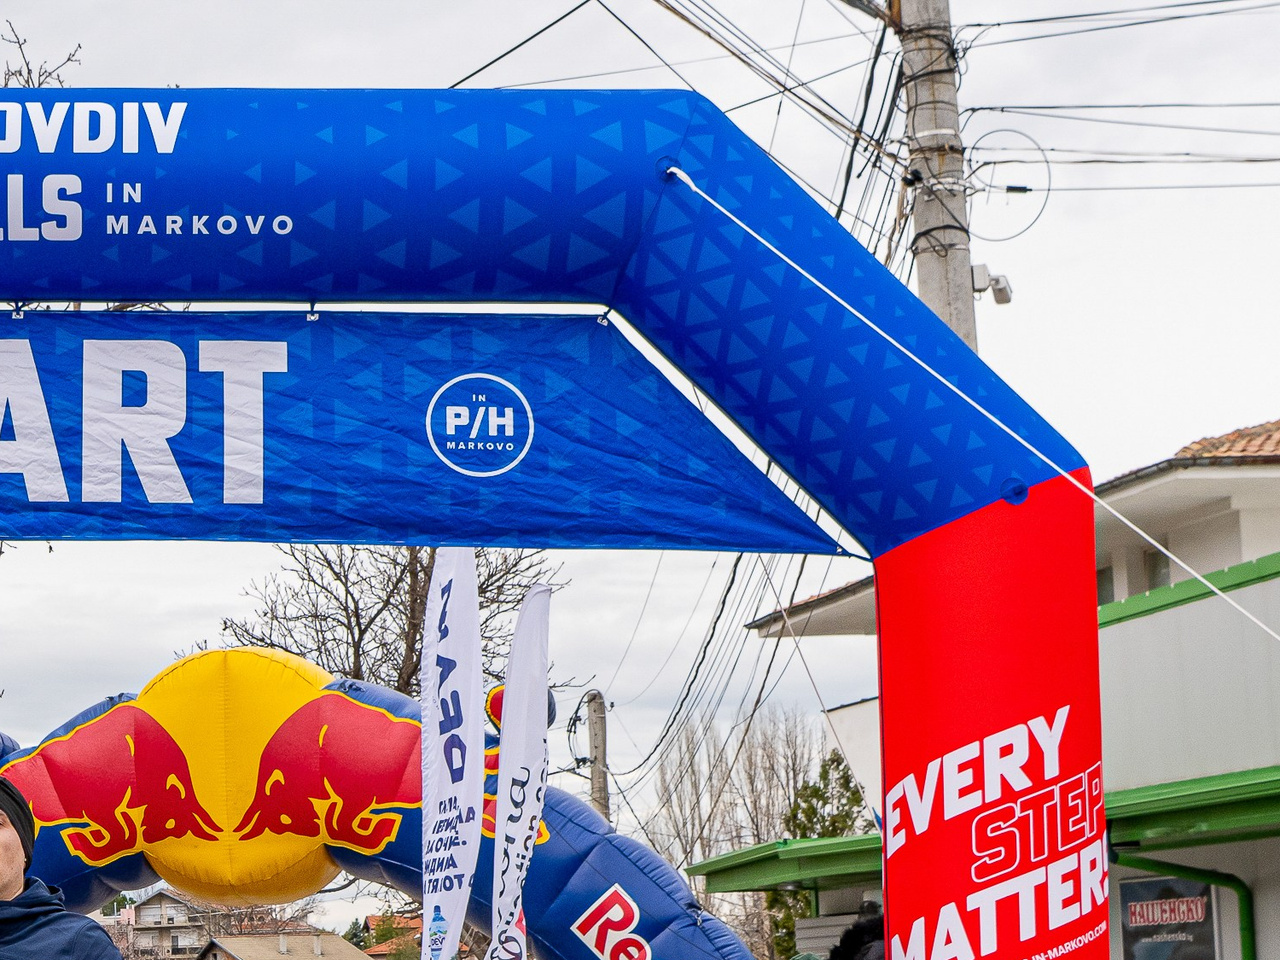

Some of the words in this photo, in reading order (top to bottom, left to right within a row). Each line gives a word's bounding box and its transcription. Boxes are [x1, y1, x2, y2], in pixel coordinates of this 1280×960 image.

[106, 183, 141, 203] IN
[106, 214, 294, 235] MARKOVO
[472, 394, 486, 402] IN
[446, 405, 514, 439] P/H
[446, 441, 514, 451] MARKOVO
[886, 705, 1070, 859] EVERY
[971, 760, 1104, 883] STEP
